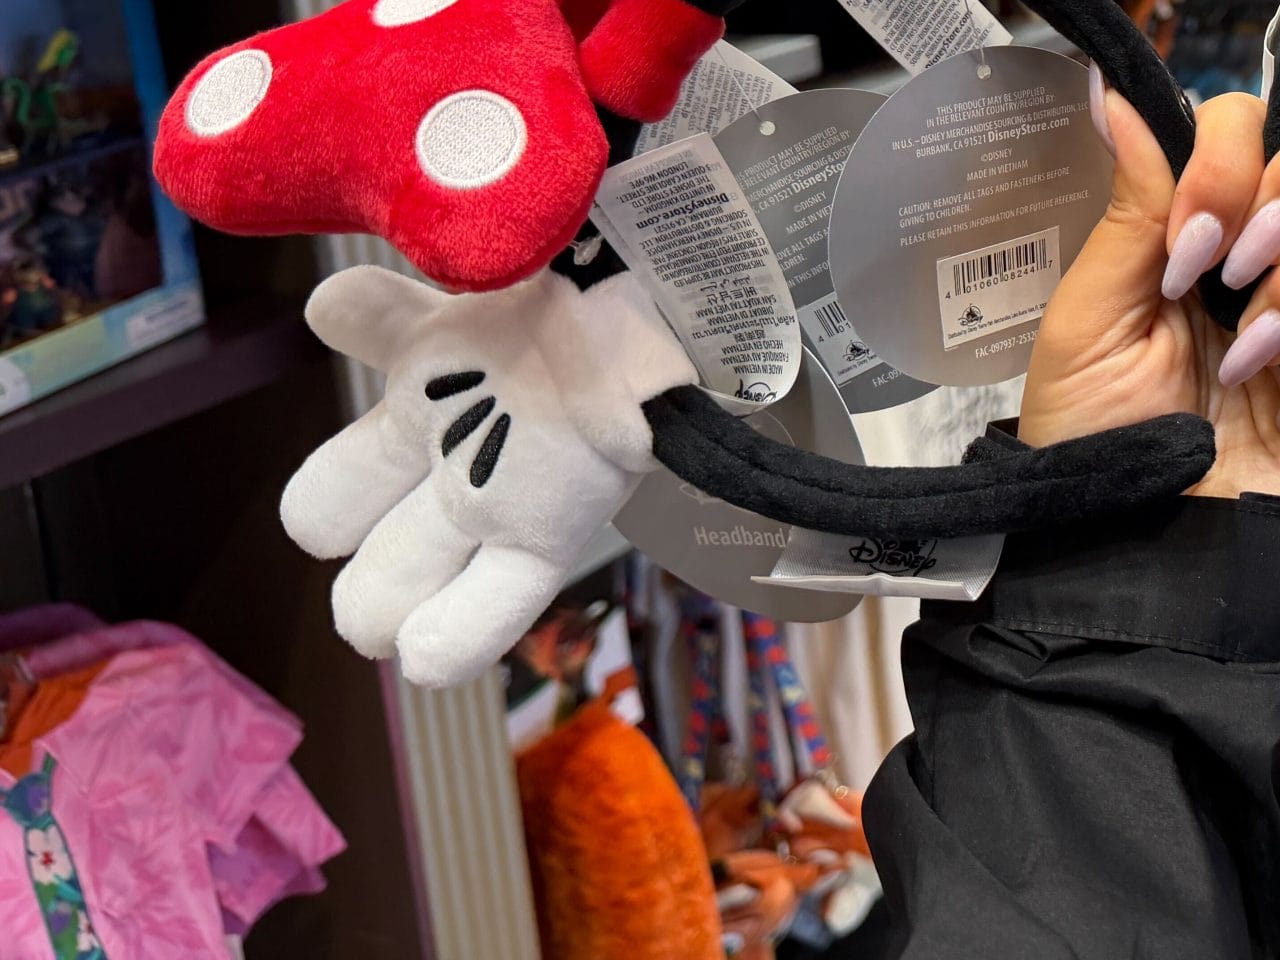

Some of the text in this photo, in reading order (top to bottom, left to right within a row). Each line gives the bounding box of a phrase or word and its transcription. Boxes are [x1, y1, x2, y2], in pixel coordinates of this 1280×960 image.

[936, 86, 1044, 115] THIS PRODUCT MAY BE SUPPLIED
[891, 140, 901, 150] IN
[901, 138, 913, 148] U.S.
[920, 131, 945, 144] DISNEY
[946, 121, 993, 138] MERCHANDISE
[993, 114, 1026, 128] SOURCING
[1026, 112, 1032, 120] &
[915, 115, 1070, 158] BURBANK, CA 91521 DisneyStore.com
[743, 125, 838, 178] PRODUCT MAY BE SUPPLIED
[615, 163, 711, 204] 3 QUEEN CAROLINE STREET,
[628, 160, 688, 189] LONDON W6 9PE
[966, 159, 1028, 181] MADE IN VIETNAM
[631, 173, 710, 208] THE DISNEY STORE LTD
[643, 182, 715, 214] IN UNITED KINGDOM
[758, 199, 769, 211] CA
[767, 188, 793, 206] 91521
[932, 193, 963, 208] REMOVE
[962, 190, 976, 200] ALL
[976, 185, 994, 197] TAGS
[994, 181, 1009, 192] AND
[1009, 172, 1046, 188] FASTENERS
[1045, 166, 1070, 179] BEFORE
[635, 190, 728, 230] DisneyStore.com
[653, 204, 723, 234] BURBANK, CA 91521
[703, 219, 711, 228] &
[709, 207, 748, 227] SOURCING
[784, 204, 833, 234] MADE IN VIET
[898, 214, 925, 228] GIVING
[925, 211, 935, 221] TO
[899, 198, 1053, 246] PLEASE RETAIN THIS INFORMATION FOR FUTURE
[638, 238, 653, 249] LLC
[644, 217, 752, 257] IN U.S. DISNEY MERCHANDISE
[791, 231, 824, 252] ALL TAGS
[673, 257, 764, 288] THIS PRODUCT MAY BE SUPPLIED
[793, 270, 811, 284] THIS
[692, 524, 787, 548] Headband
